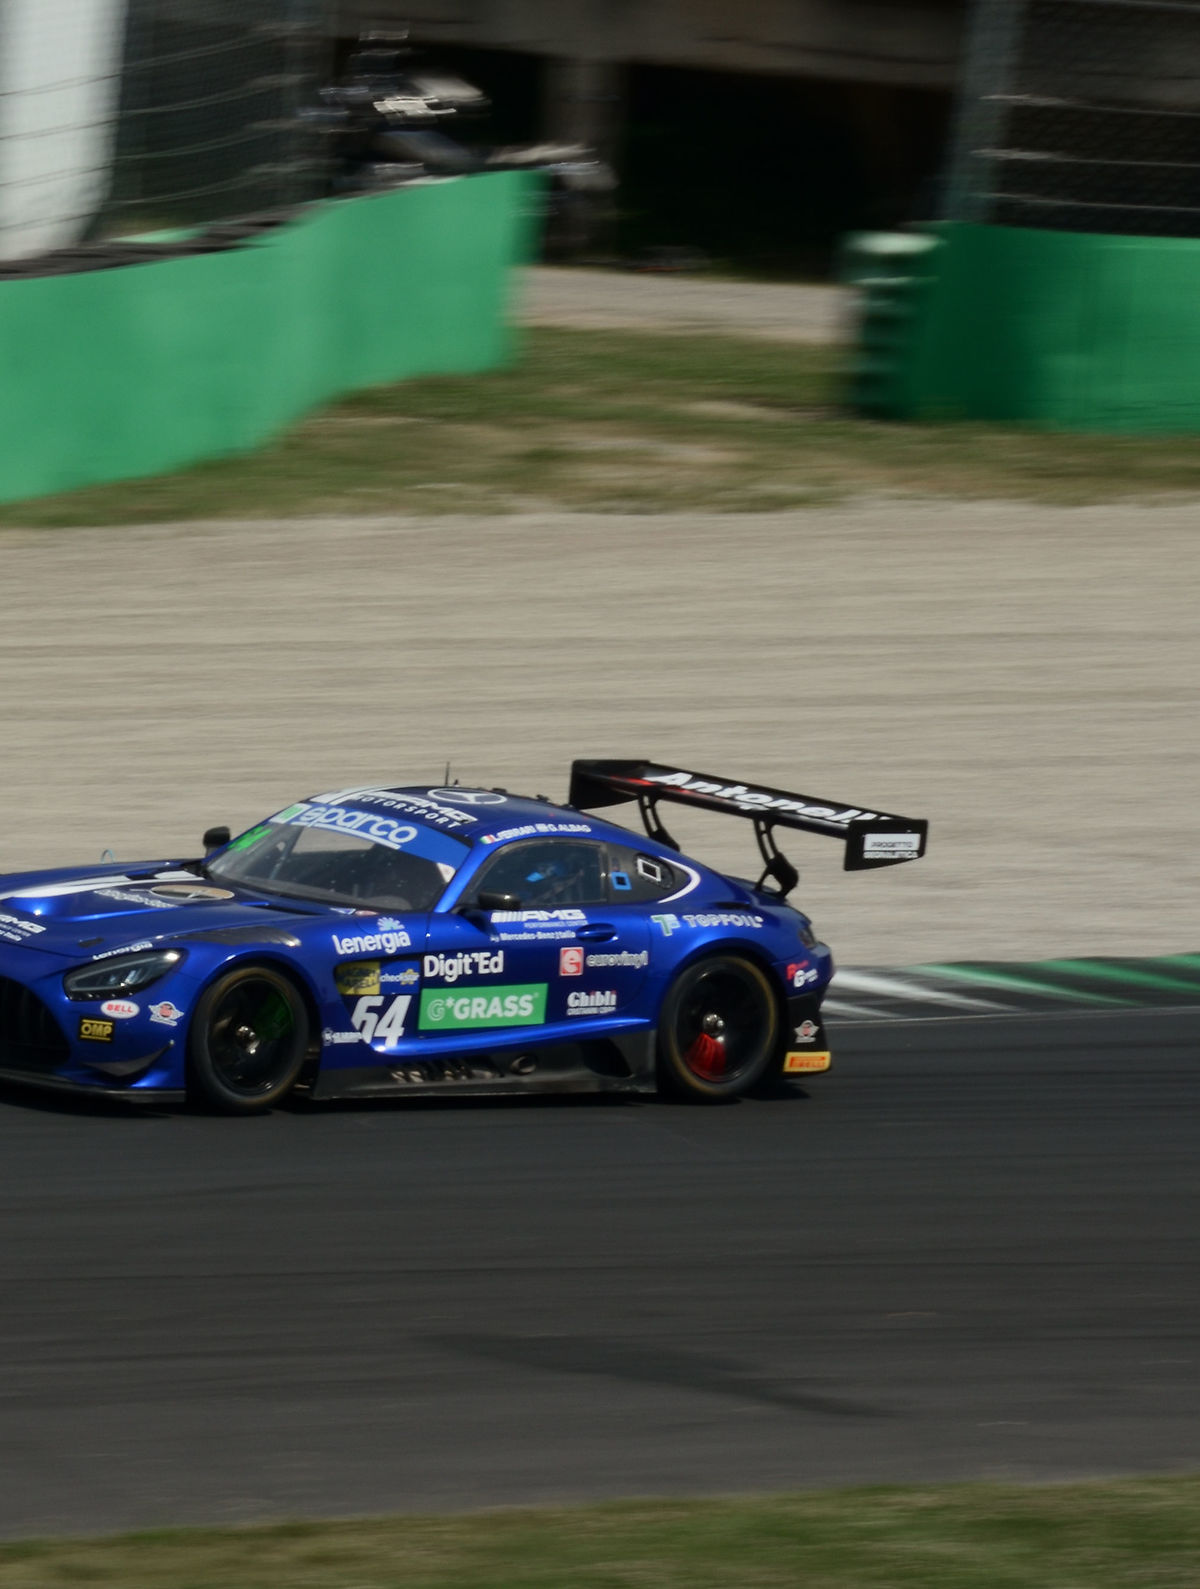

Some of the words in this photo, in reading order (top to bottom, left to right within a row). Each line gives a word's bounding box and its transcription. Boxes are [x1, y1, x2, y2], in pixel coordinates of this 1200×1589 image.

[301, 806, 418, 843] sparco
[567, 990, 617, 1008] Ghibli
[106, 1003, 133, 1013] BELL
[81, 1023, 112, 1036] OMP
